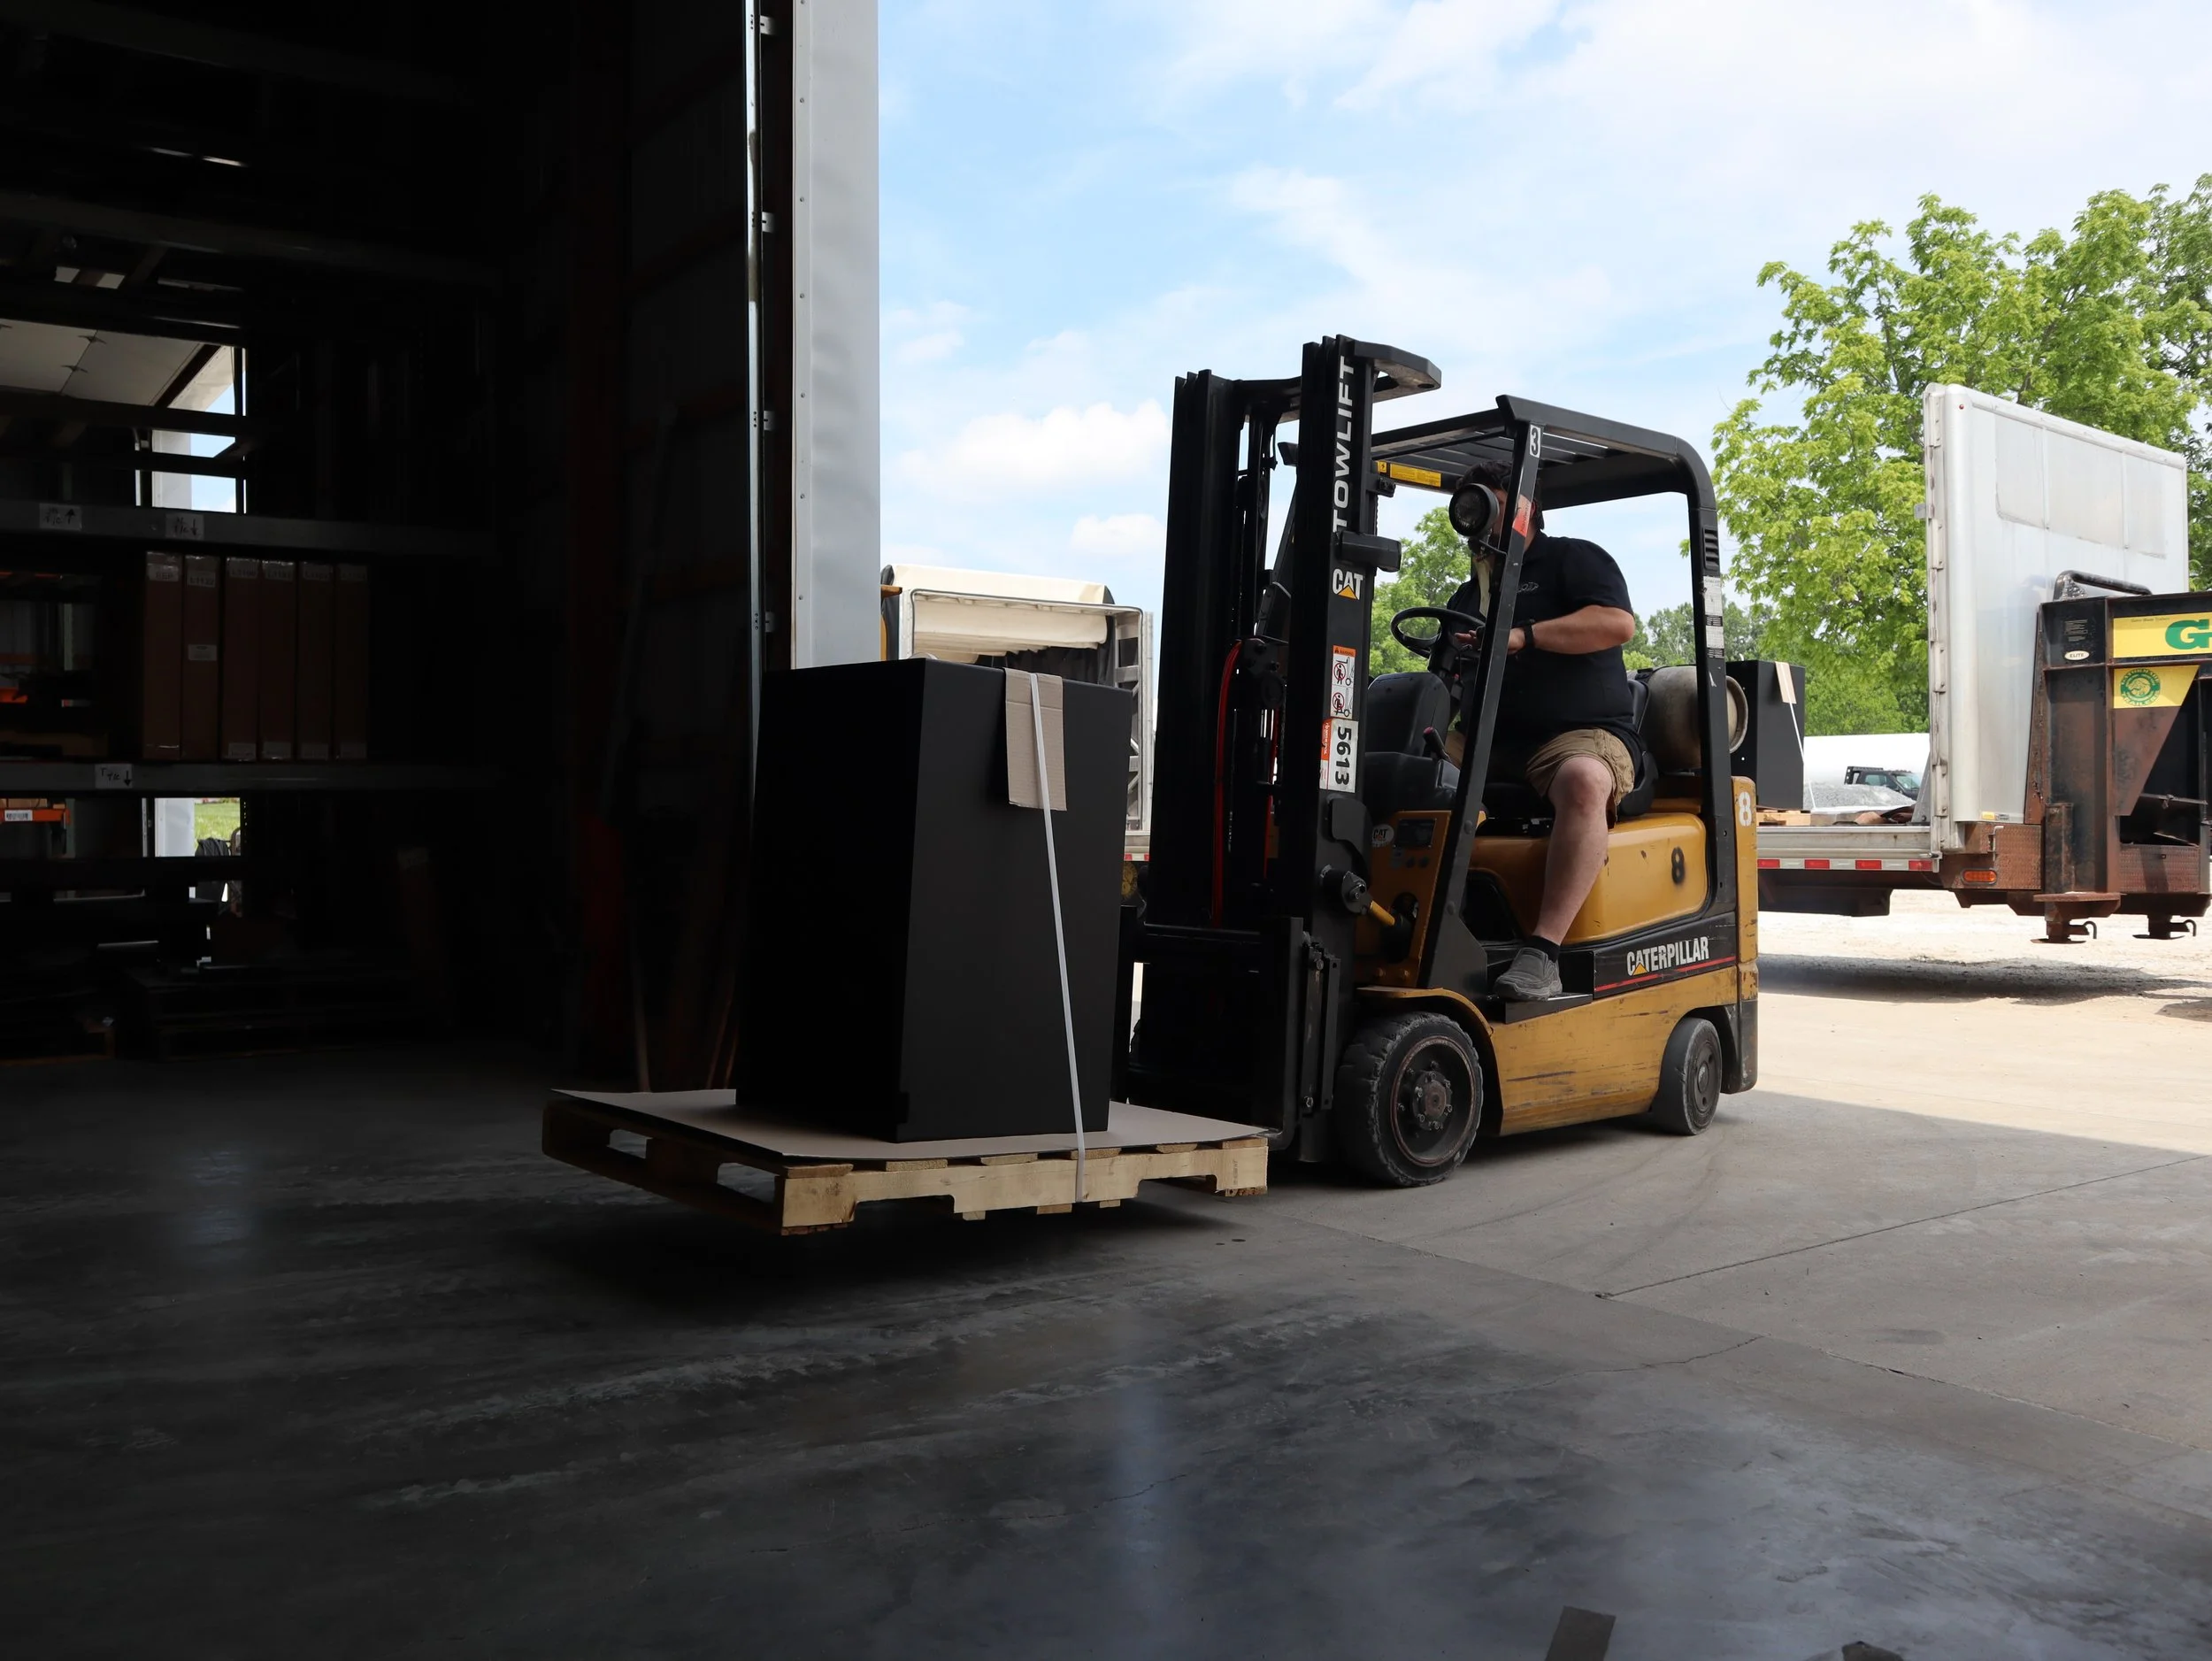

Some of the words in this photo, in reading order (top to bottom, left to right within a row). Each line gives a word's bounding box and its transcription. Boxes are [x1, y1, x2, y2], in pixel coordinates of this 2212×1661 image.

[1333, 355, 1355, 533] TOWLIFT
[1530, 427, 1540, 457] 3
[1333, 568, 1363, 600] CAT
[1334, 726, 1352, 786] 5613
[1739, 792, 1753, 827] 8
[1373, 828, 1387, 840] CAT
[1671, 846, 1685, 885] 8
[1626, 936, 1710, 976] CATERPILLAR
